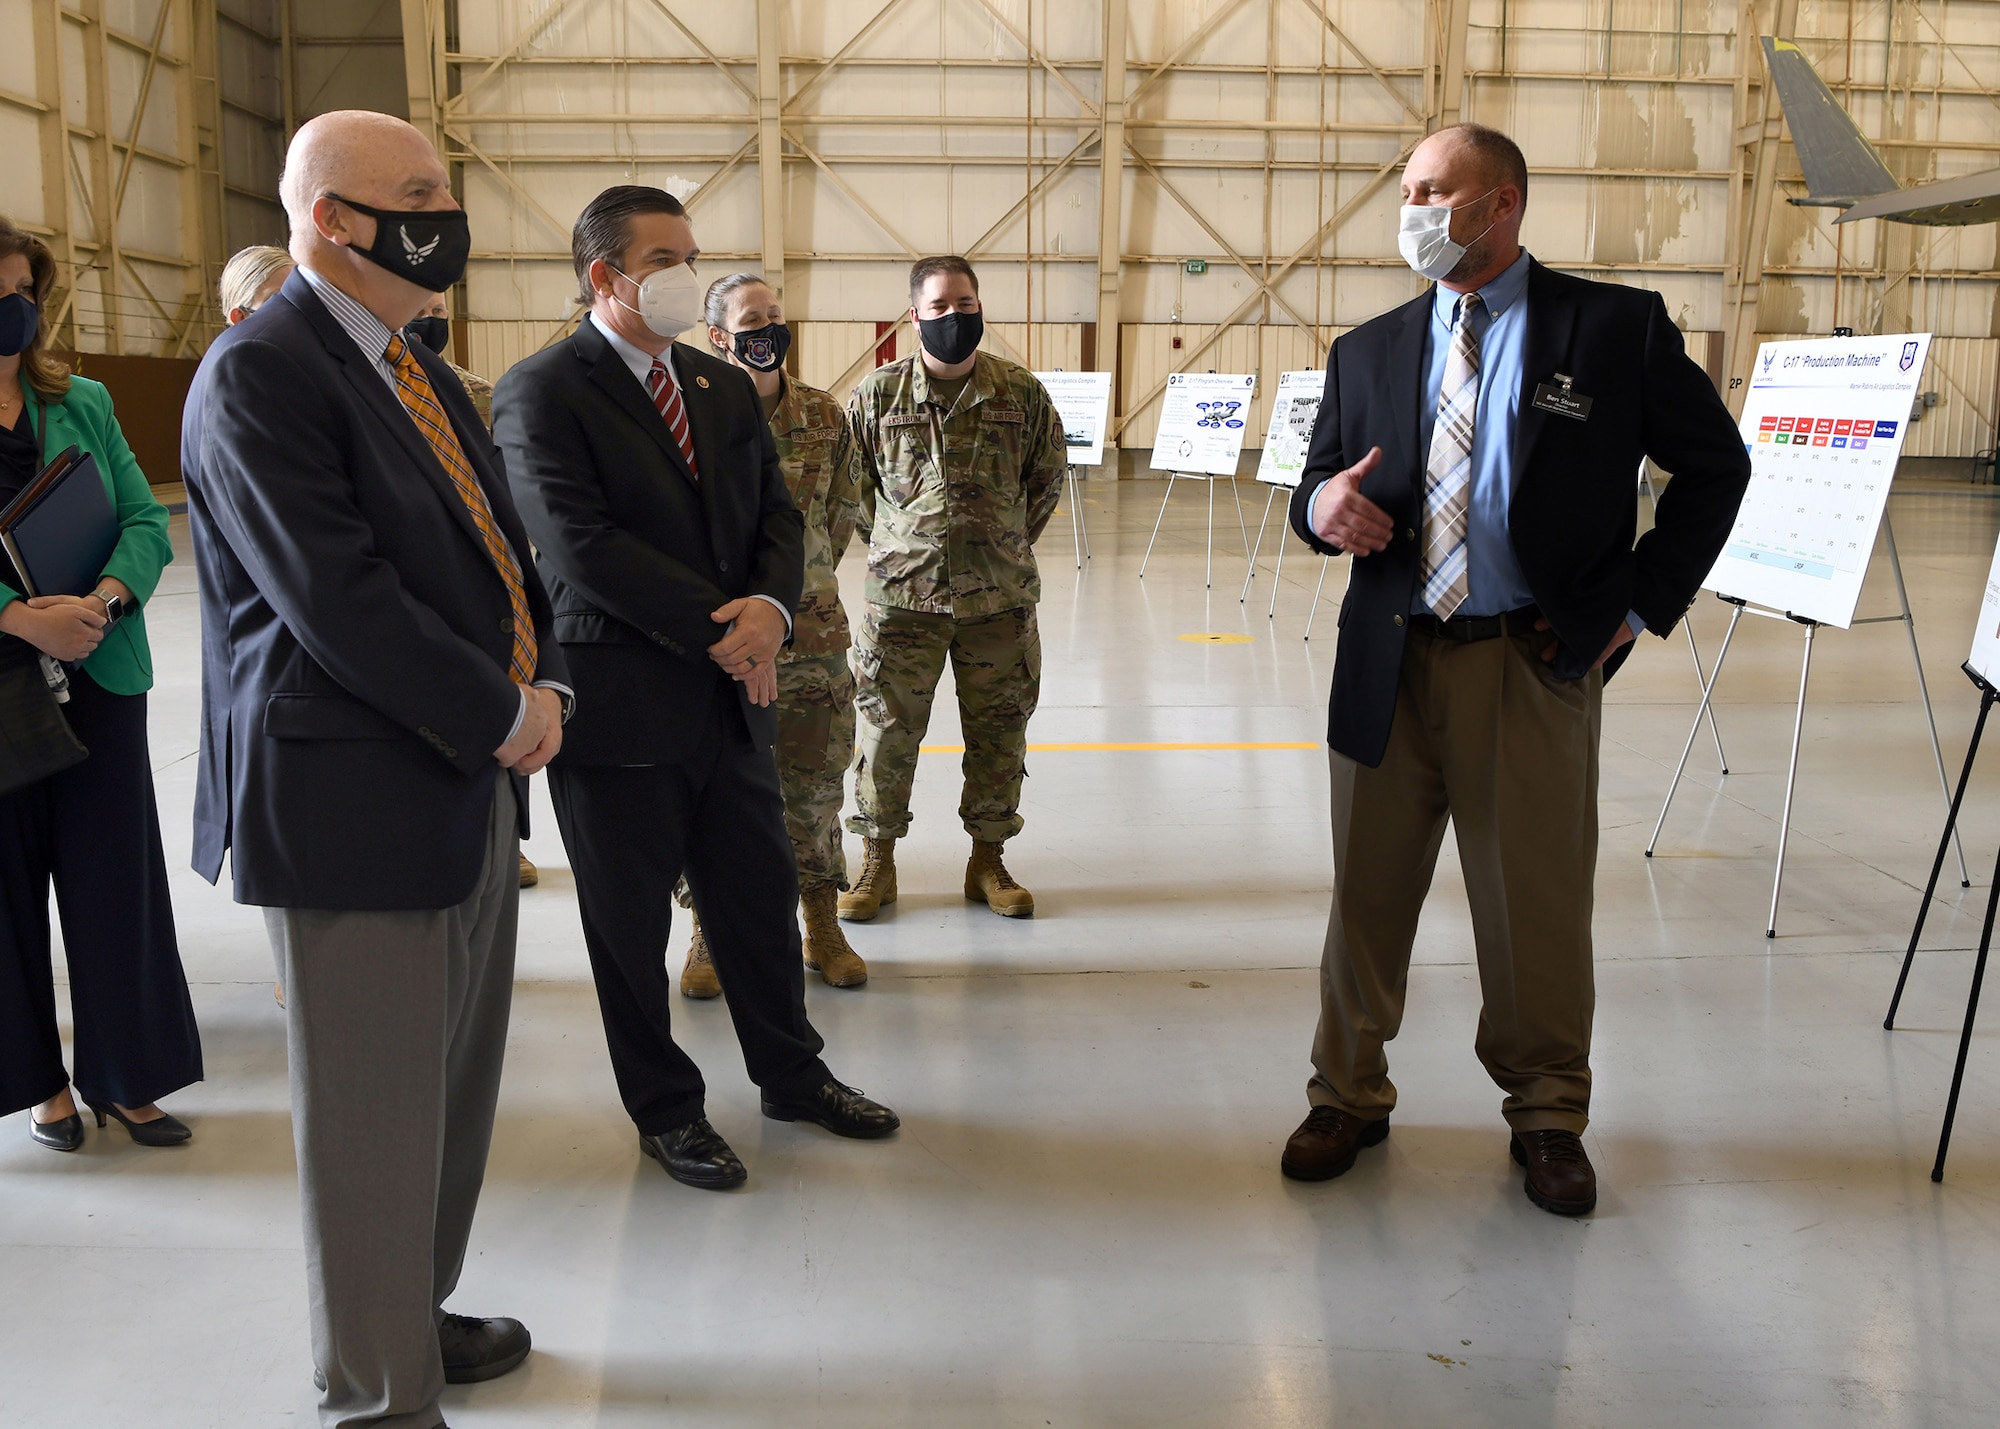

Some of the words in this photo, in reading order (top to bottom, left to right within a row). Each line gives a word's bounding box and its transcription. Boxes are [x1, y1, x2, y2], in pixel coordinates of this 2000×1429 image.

[1783, 356, 1800, 368] C-17
[1729, 378, 1742, 389] 2P
[1546, 394, 1560, 402] Ben
[1560, 398, 1580, 408] Stuart
[888, 415, 921, 425] EKSTROM
[817, 430, 838, 440] FORCE
